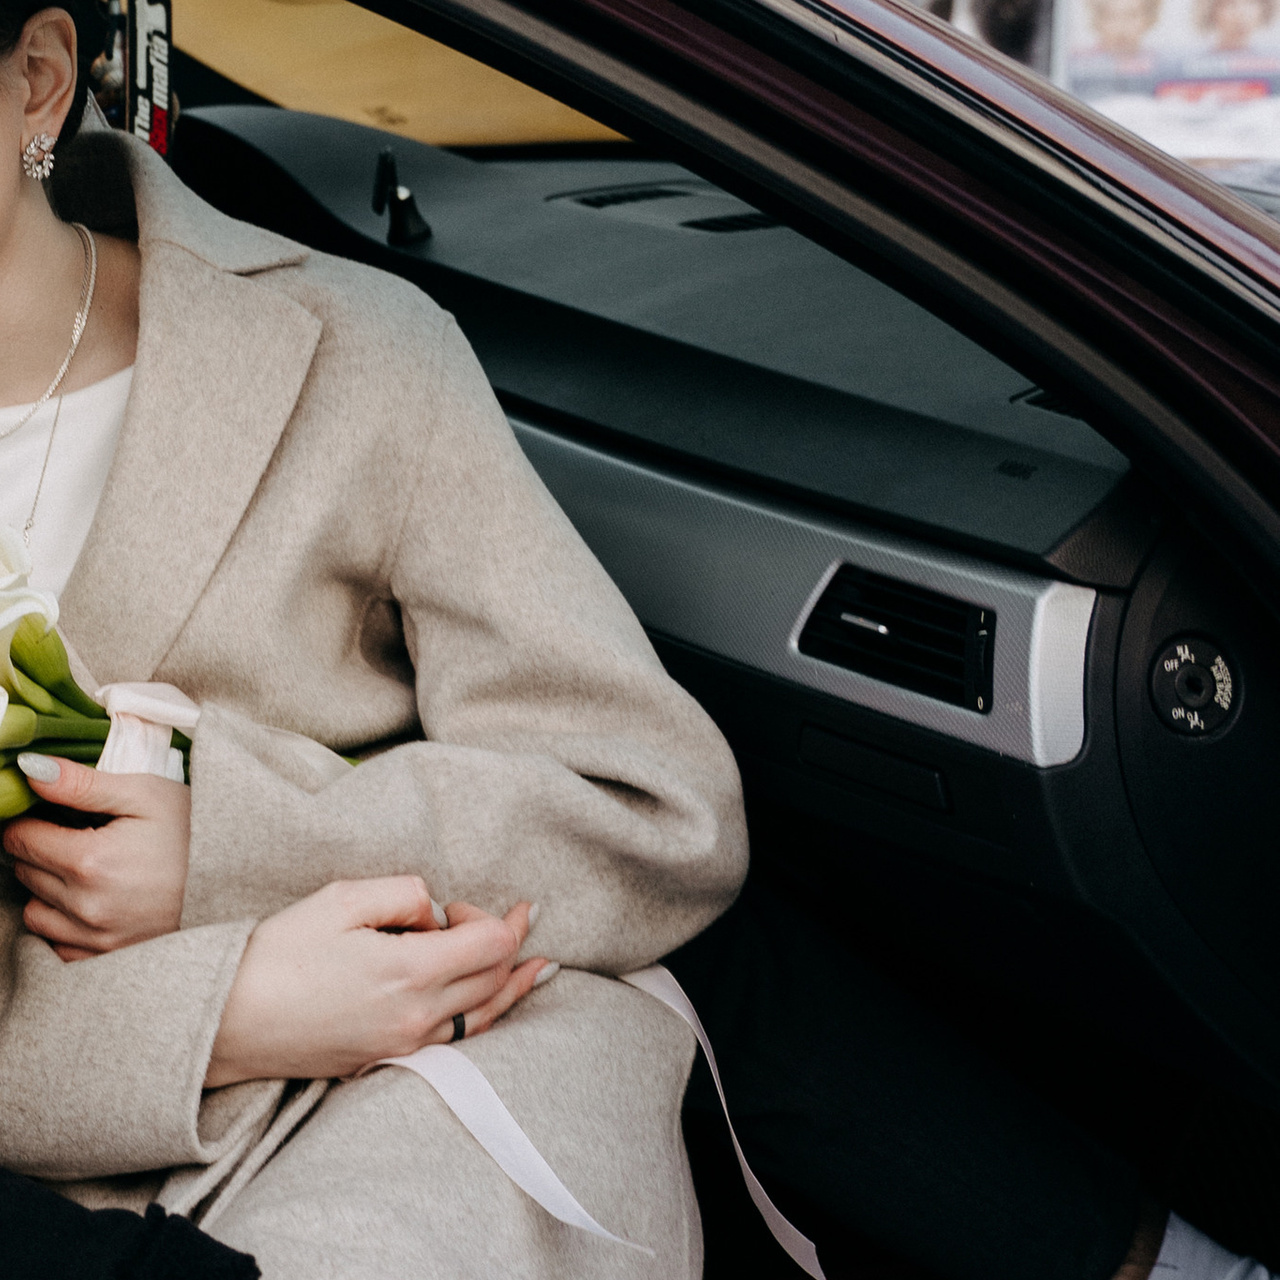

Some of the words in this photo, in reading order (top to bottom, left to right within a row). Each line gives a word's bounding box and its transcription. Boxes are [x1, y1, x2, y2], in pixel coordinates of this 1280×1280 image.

[149, 34, 168, 110] mafia
[1164, 659, 1179, 672] OFF
[1172, 707, 1185, 720] ON
